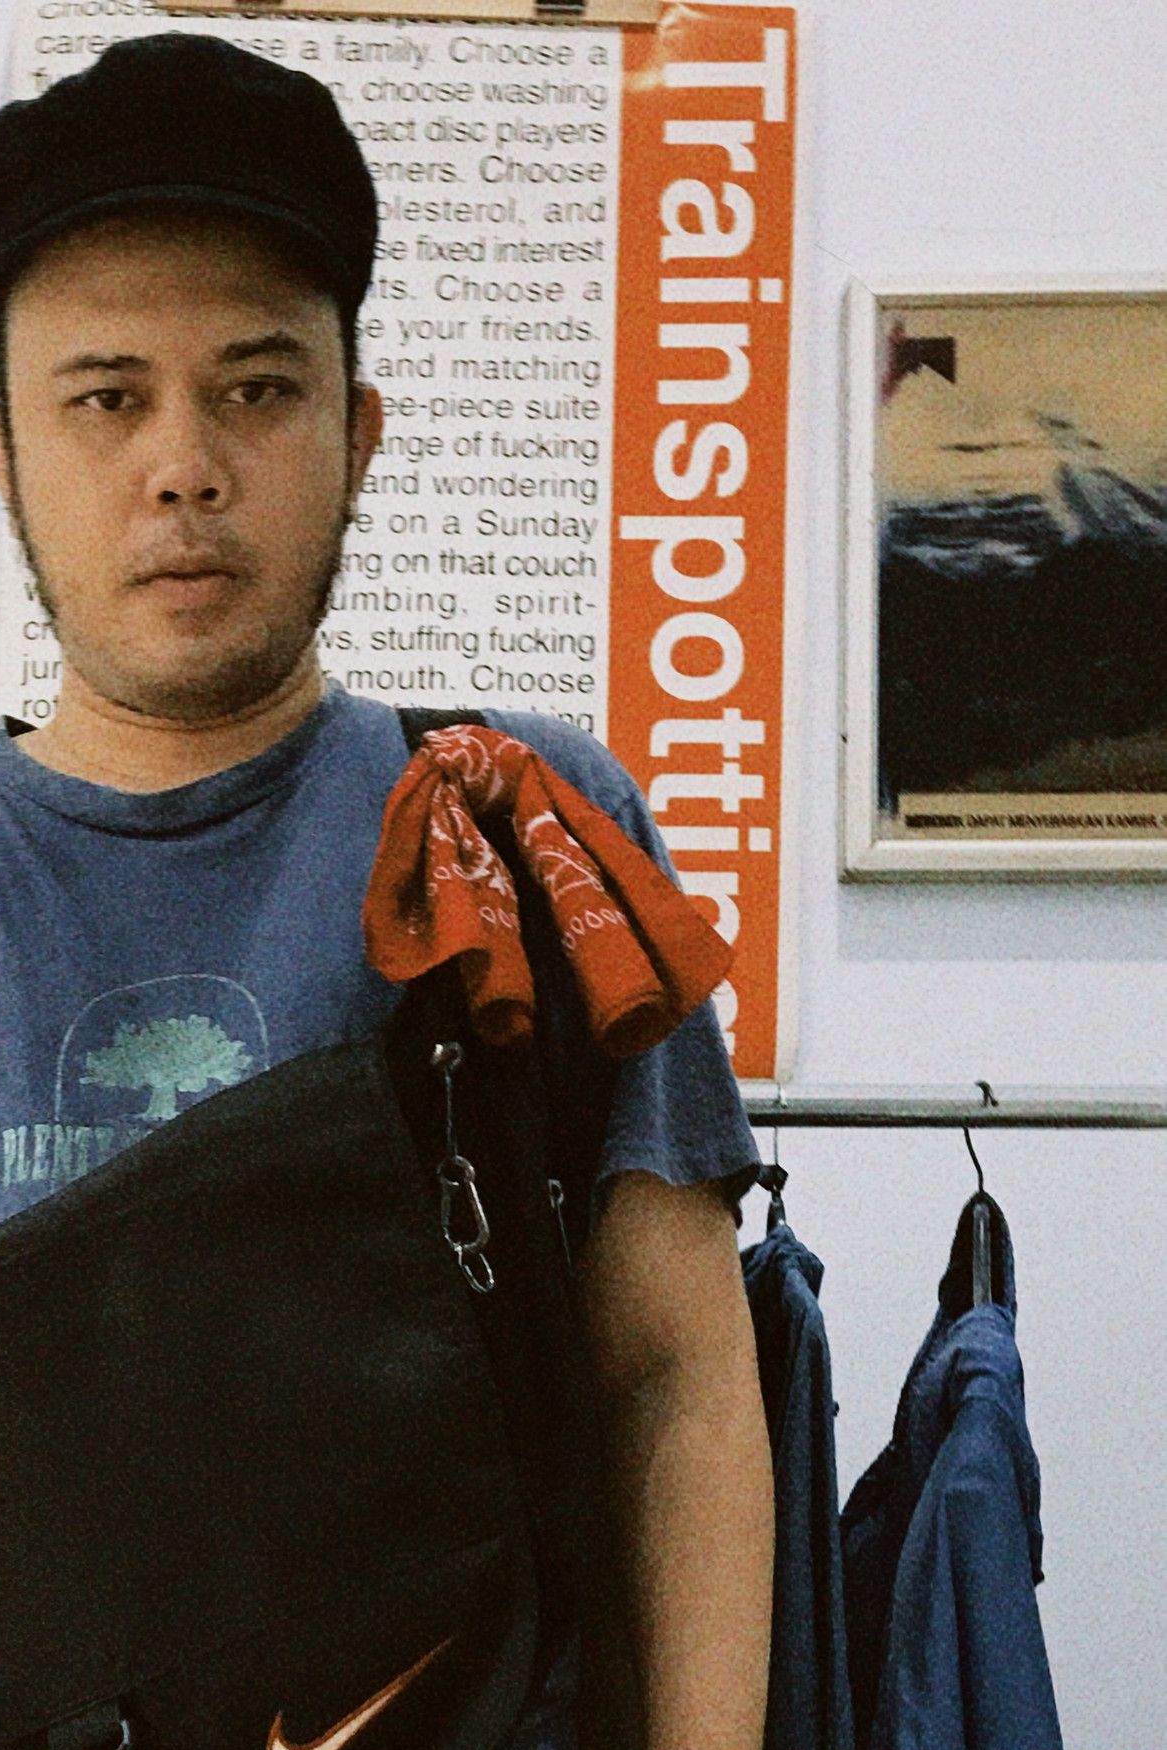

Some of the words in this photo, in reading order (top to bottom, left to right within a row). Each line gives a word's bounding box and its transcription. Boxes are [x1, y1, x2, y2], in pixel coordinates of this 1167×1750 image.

[299, 39, 321, 60] a
[334, 35, 435, 69] family.
[448, 36, 574, 65] Choose
[587, 44, 609, 65] a
[361, 77, 474, 103] choose
[484, 79, 608, 111] washing
[423, 116, 487, 142] disc
[496, 117, 607, 150] players
[479, 154, 607, 184] Choose
[543, 196, 606, 223] and
[414, 234, 485, 262] fixed
[492, 235, 604, 263] interest
[434, 273, 564, 302] Choose
[582, 280, 603, 302] a
[397, 319, 469, 346] your
[481, 315, 601, 342] friends.
[375, 353, 434, 378] and
[451, 355, 601, 388] matching
[525, 395, 601, 420] suite
[452, 430, 484, 457] of
[491, 432, 599, 467] fucking
[361, 470, 419, 495] and
[433, 472, 598, 505] wondering
[388, 513, 428, 534] on
[442, 514, 462, 535] a
[476, 508, 599, 544] Sunday
[619, 28, 787, 1056] Trainspottin
[391, 553, 430, 573] on
[439, 548, 496, 576] that
[504, 550, 596, 577] couch
[494, 590, 597, 620] spirit-
[370, 626, 480, 659] stuffing
[489, 627, 596, 662] fucking
[346, 664, 456, 690] mouth.
[470, 663, 596, 693] Choose
